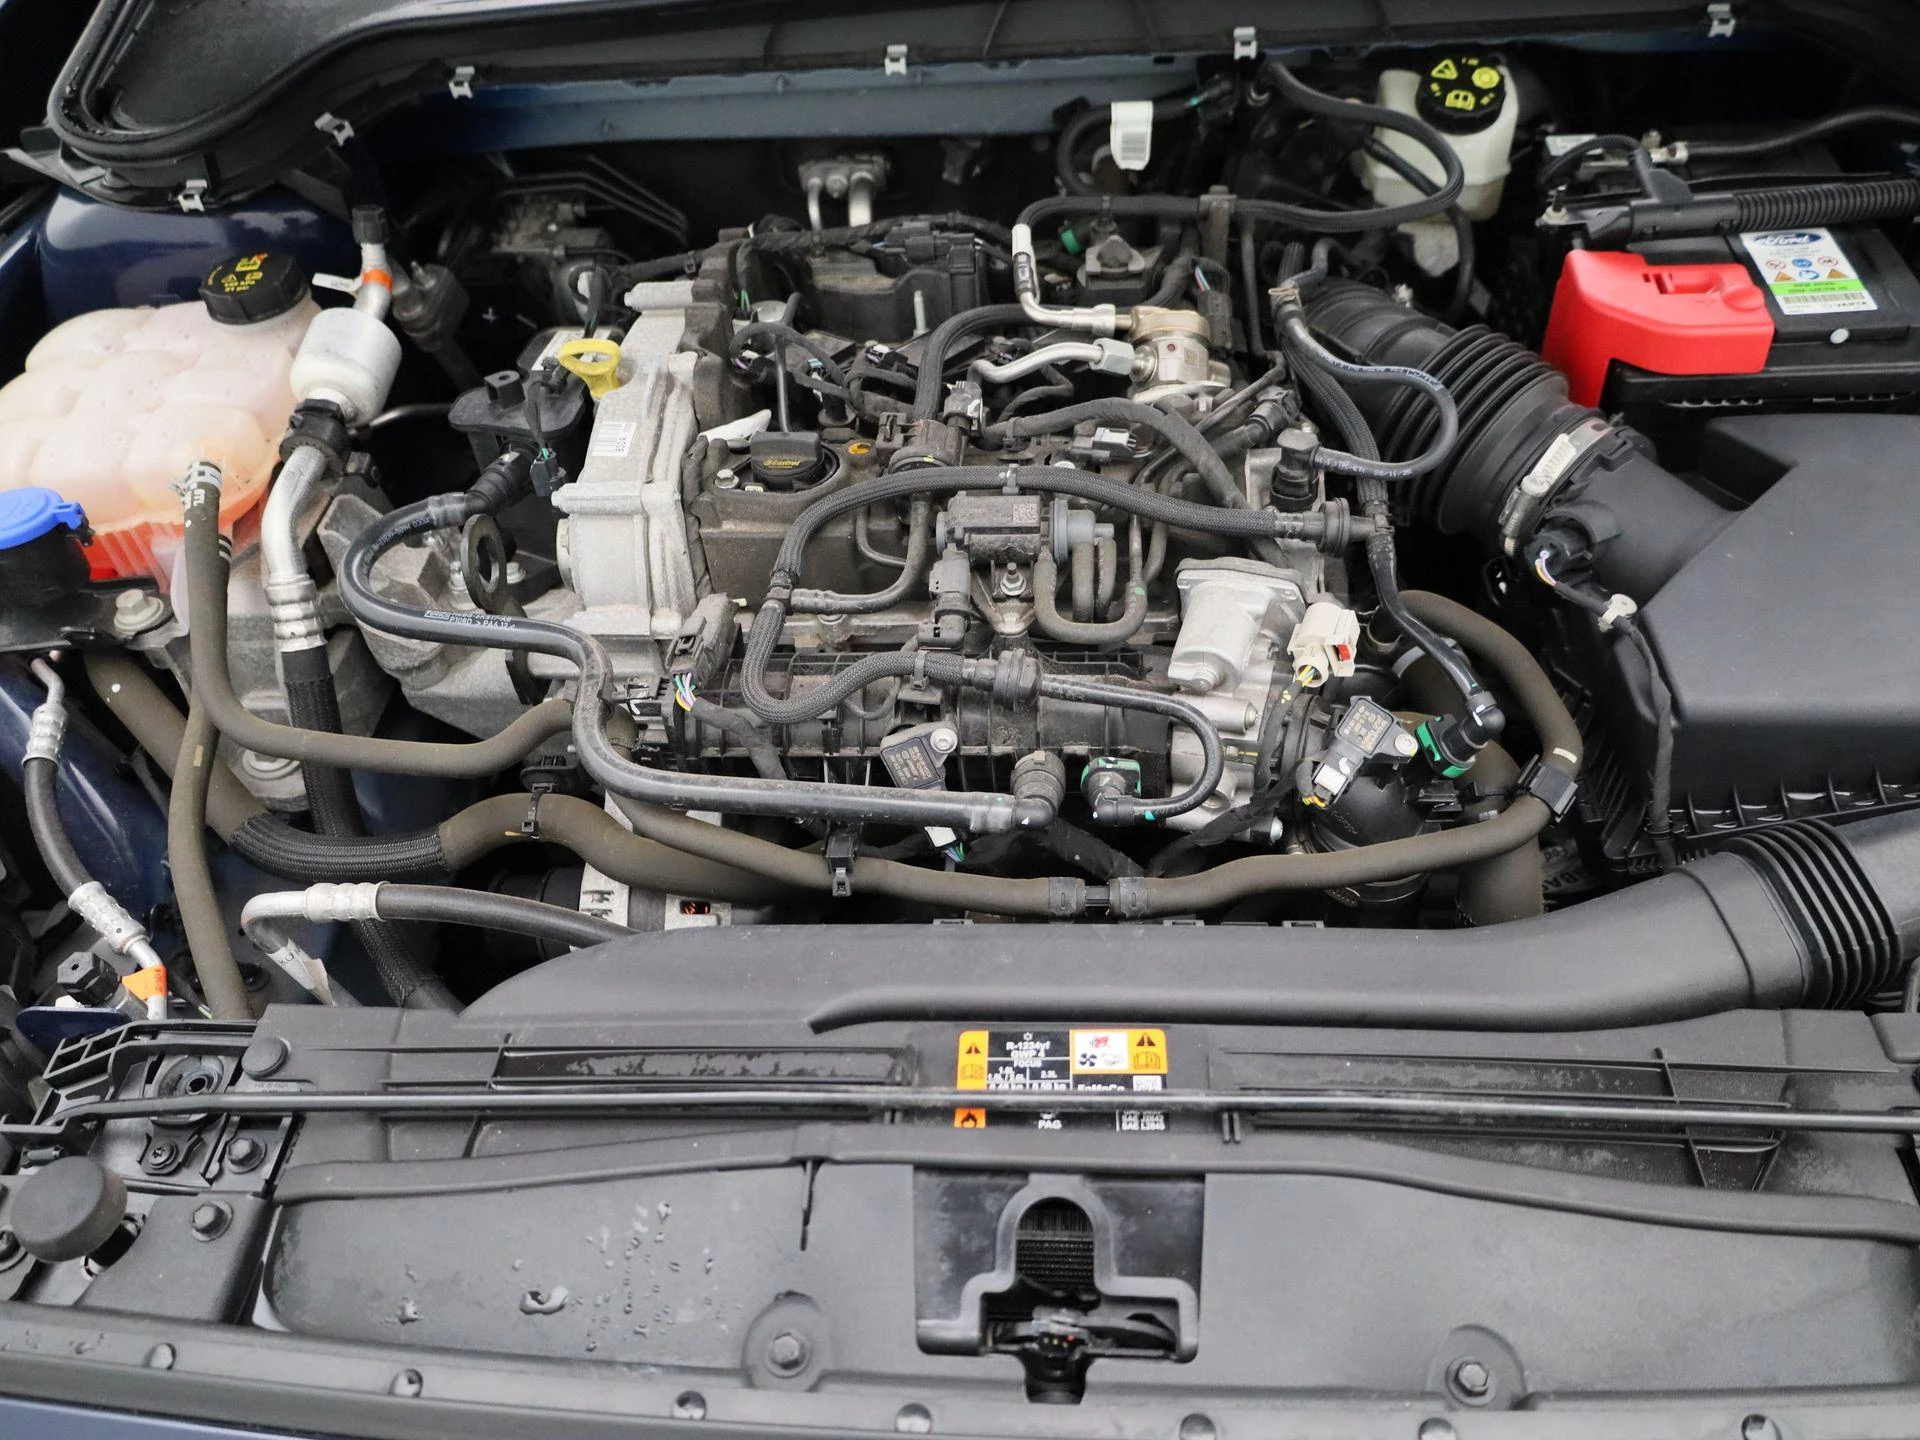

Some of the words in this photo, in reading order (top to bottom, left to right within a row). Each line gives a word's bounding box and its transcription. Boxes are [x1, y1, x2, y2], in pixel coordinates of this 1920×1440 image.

[1006, 1041, 1051, 1051] R-1234yf
[1013, 1059, 1042, 1068] FOCUS
[1037, 1120, 1062, 1129] PAG
